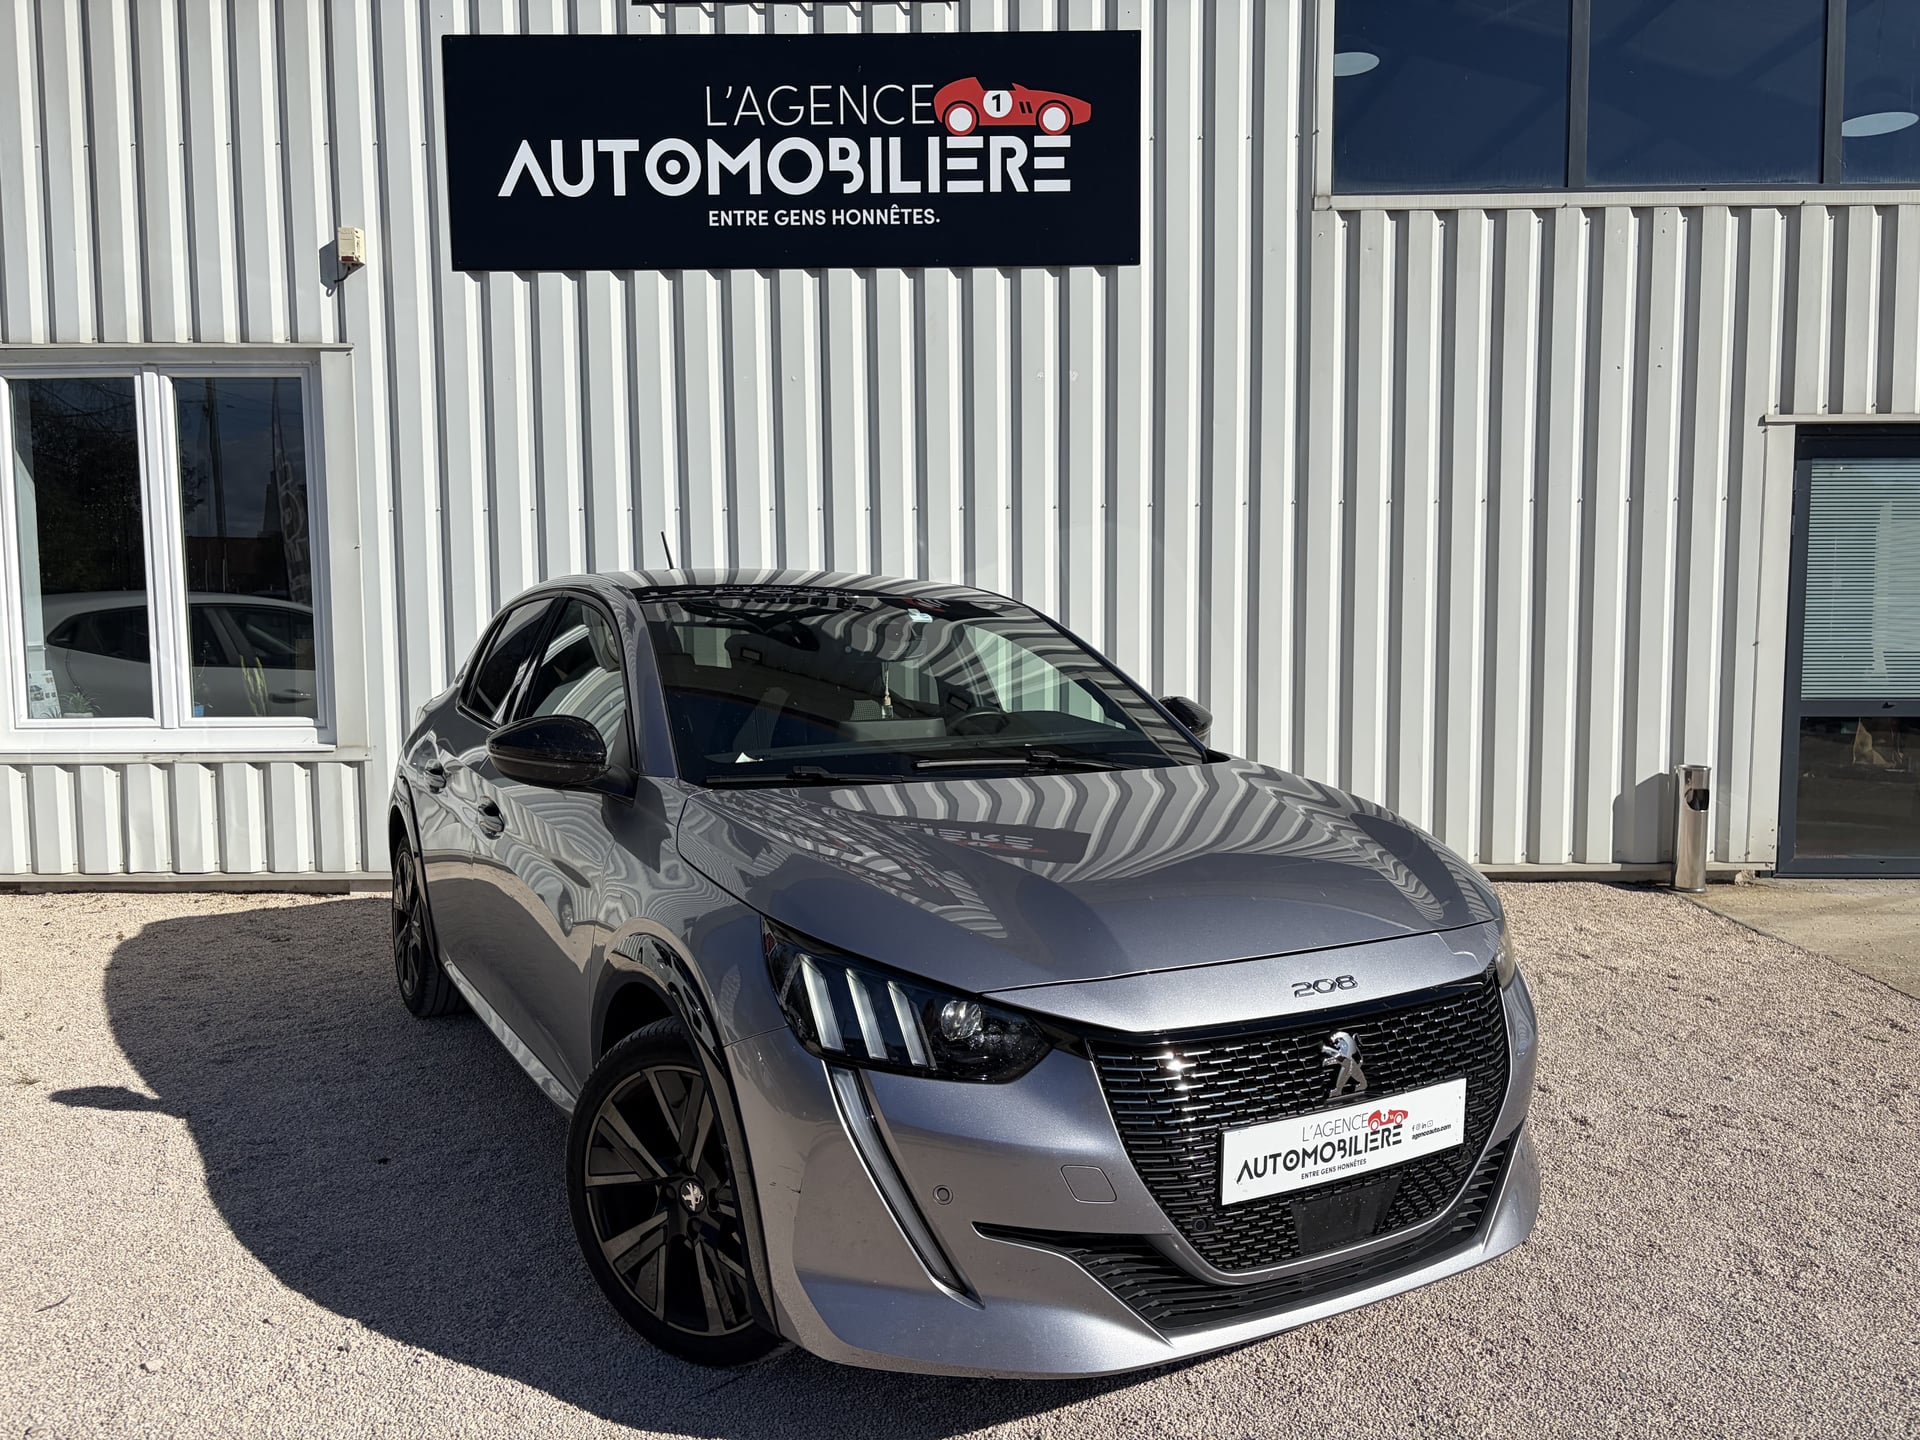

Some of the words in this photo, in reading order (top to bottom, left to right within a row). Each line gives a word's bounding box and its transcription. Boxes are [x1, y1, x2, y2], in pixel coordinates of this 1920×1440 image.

[706, 84, 935, 126] L'AGENCE
[992, 93, 1001, 112] 1
[708, 210, 769, 226] ENTRE
[774, 210, 826, 226] GENS
[832, 204, 941, 225] HONNÊTES.
[1291, 974, 1359, 998] 208
[1302, 1112, 1369, 1142] L'AGENCE
[1301, 1170, 1320, 1180] ENTRE
[1321, 1165, 1337, 1175] GENS
[1337, 1158, 1367, 1171] HONNÊTES
